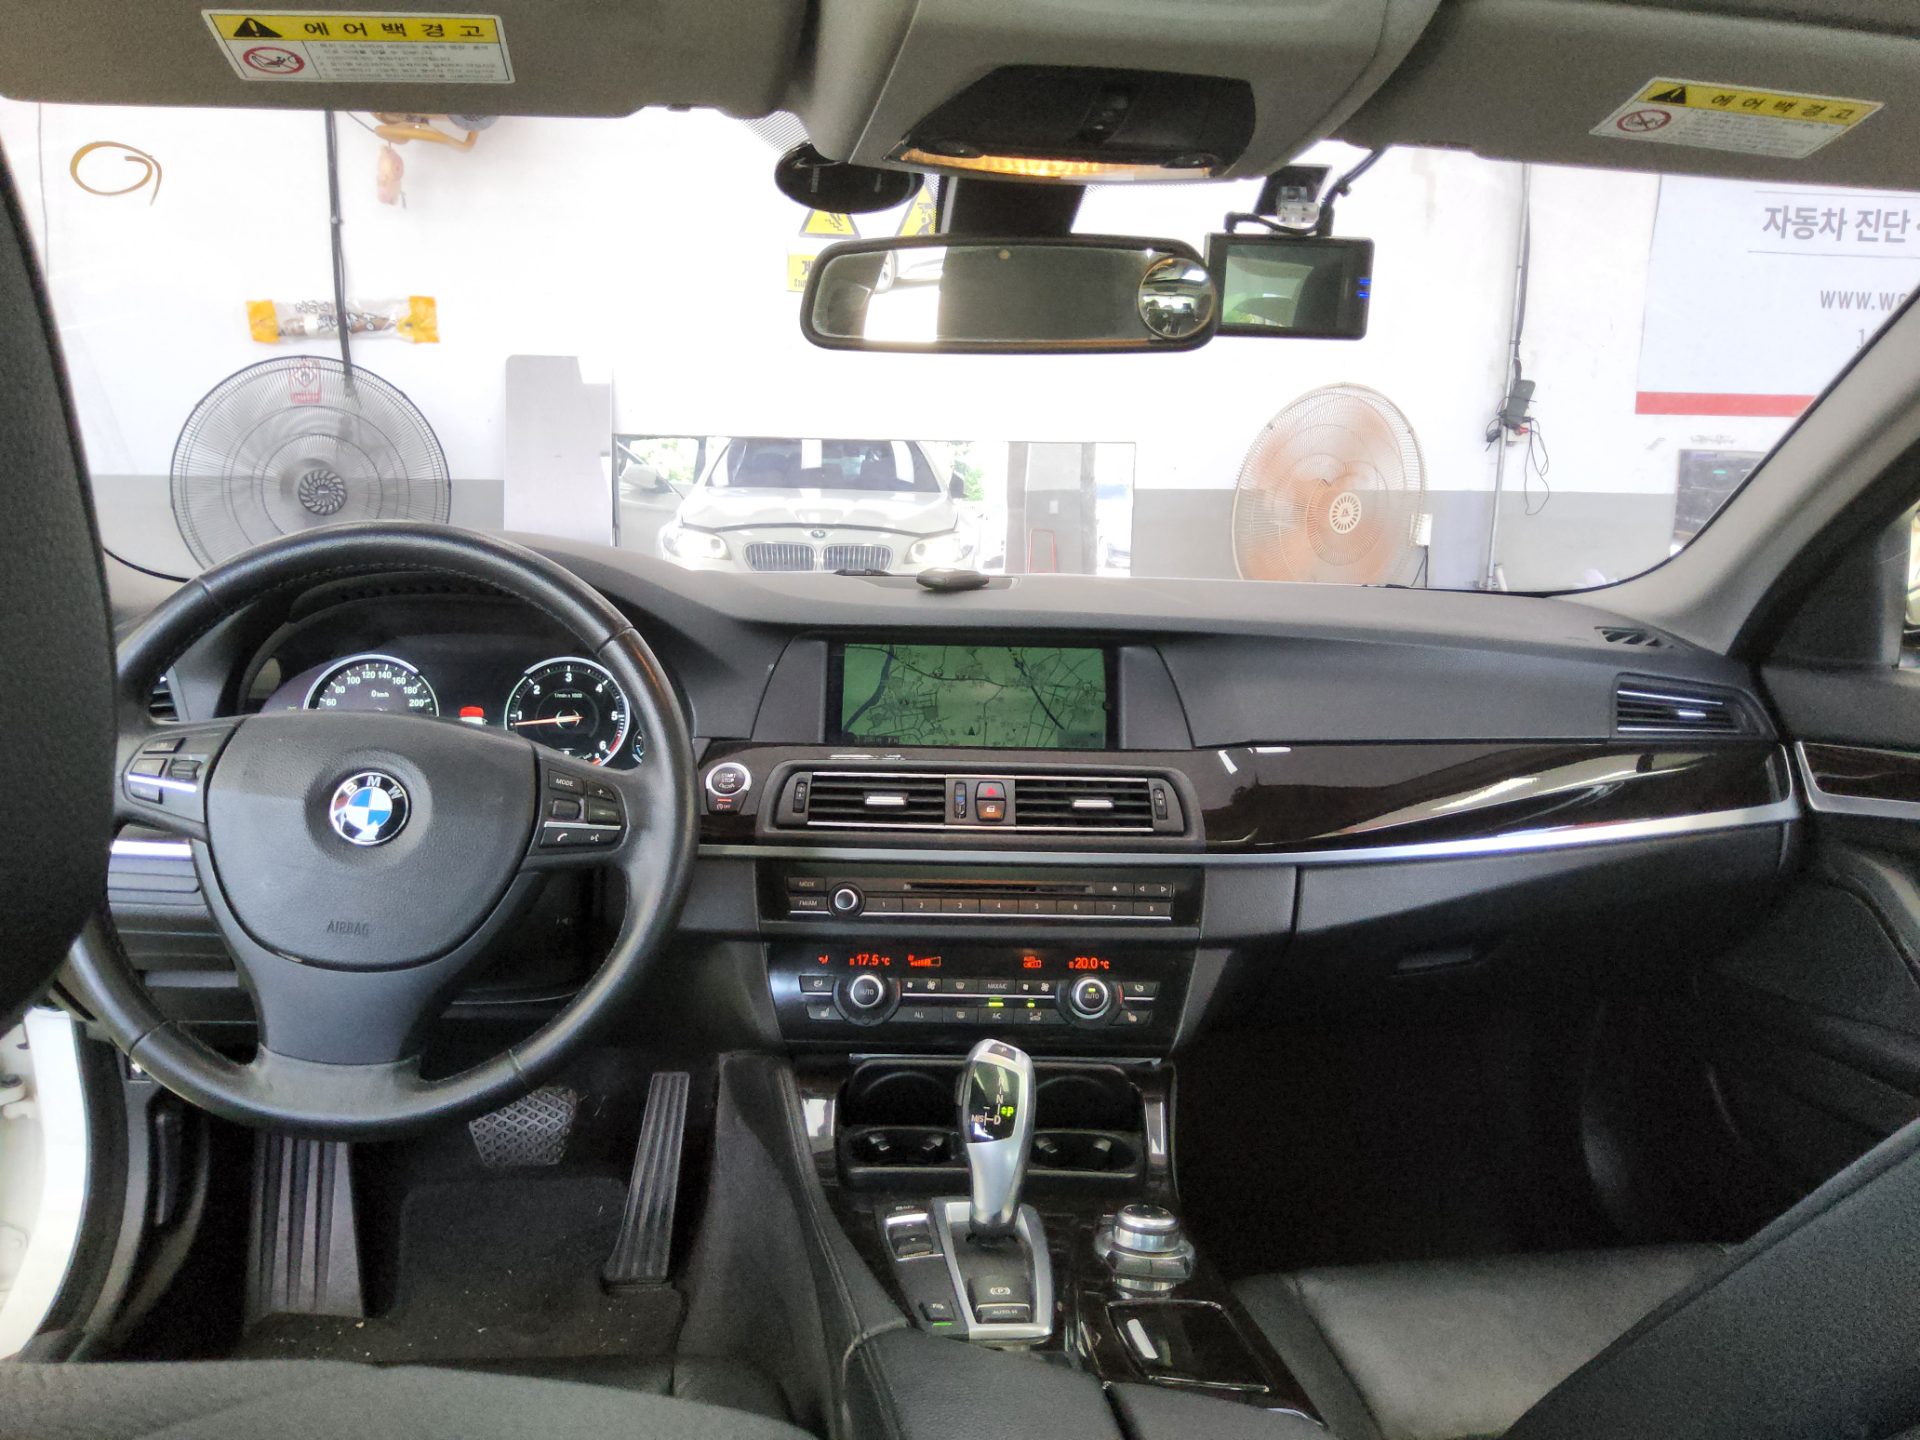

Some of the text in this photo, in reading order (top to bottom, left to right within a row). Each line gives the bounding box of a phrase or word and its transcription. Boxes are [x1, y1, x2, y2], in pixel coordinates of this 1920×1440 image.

[1763, 205, 1910, 243] 자동차 진단
[565, 672, 572, 682] 3
[533, 685, 540, 695] 2
[595, 683, 603, 693] 4
[409, 699, 424, 707] 200
[517, 711, 522, 720] 1
[611, 711, 618, 720] 5
[599, 741, 606, 750] 6
[341, 775, 403, 800] BMW
[556, 778, 573, 787] MODE
[327, 920, 370, 936] AIRBAG
[856, 954, 879, 966] 17.5
[1074, 957, 1098, 969] 20.0
[996, 1094, 1004, 1104] N
[993, 1115, 1001, 1125] D
